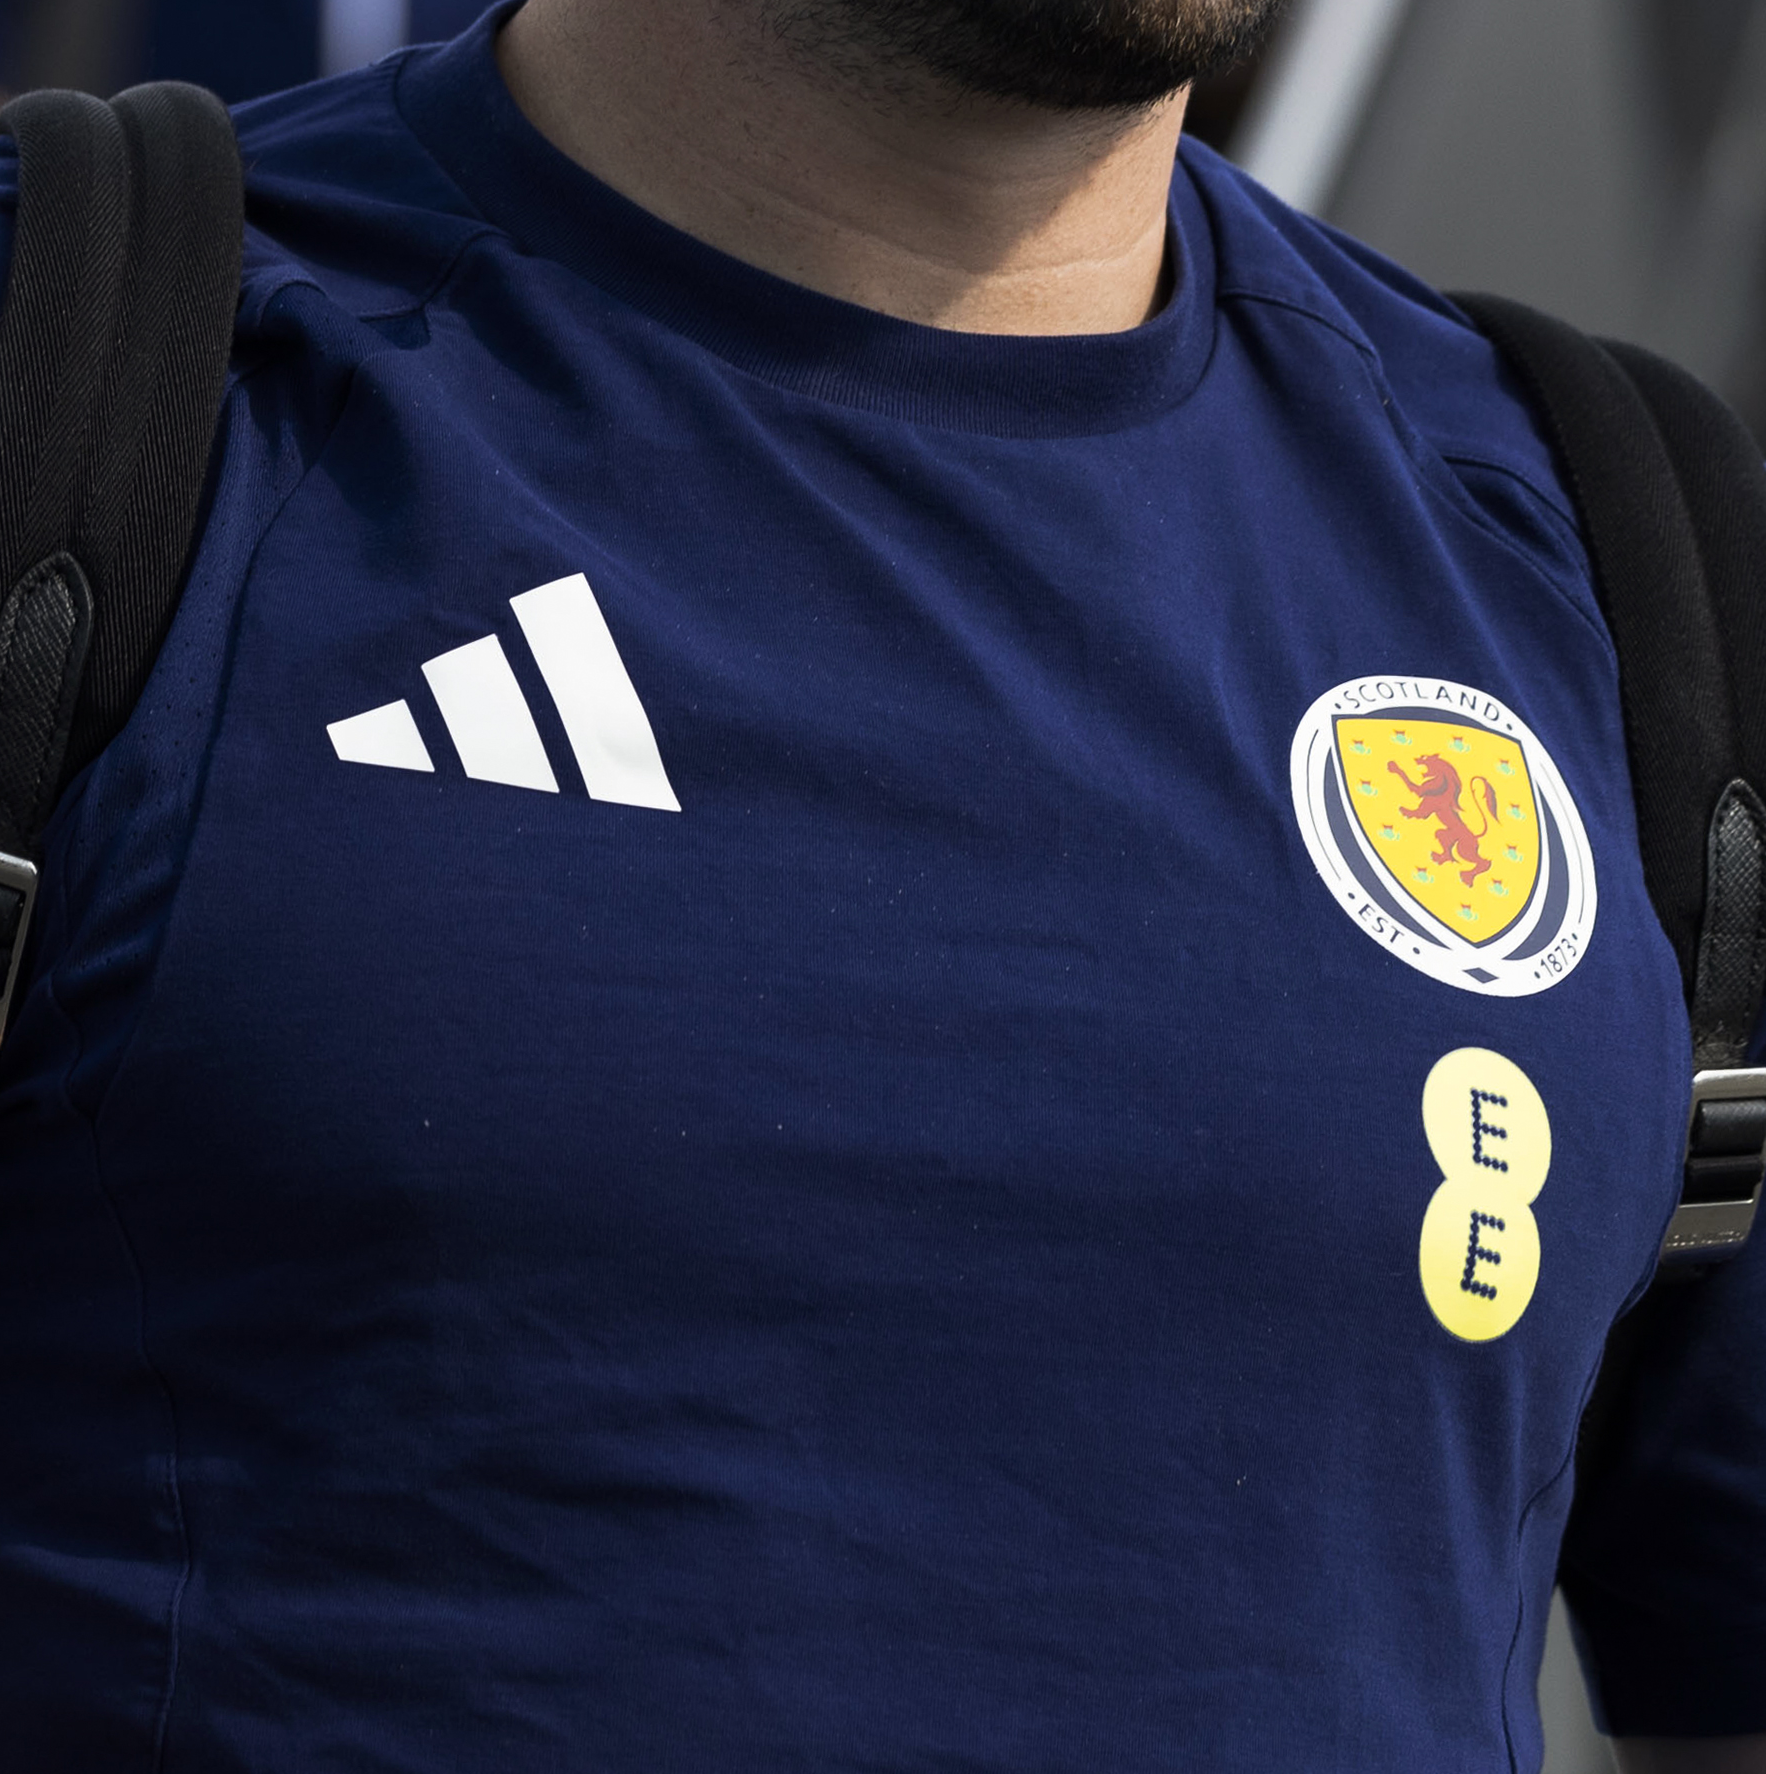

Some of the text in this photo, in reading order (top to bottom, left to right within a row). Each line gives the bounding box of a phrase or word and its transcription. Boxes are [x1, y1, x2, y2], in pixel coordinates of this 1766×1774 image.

[1342, 681, 1501, 722] SCOTLAND
[1357, 903, 1405, 944] EST
[1539, 937, 1578, 978] 1873
